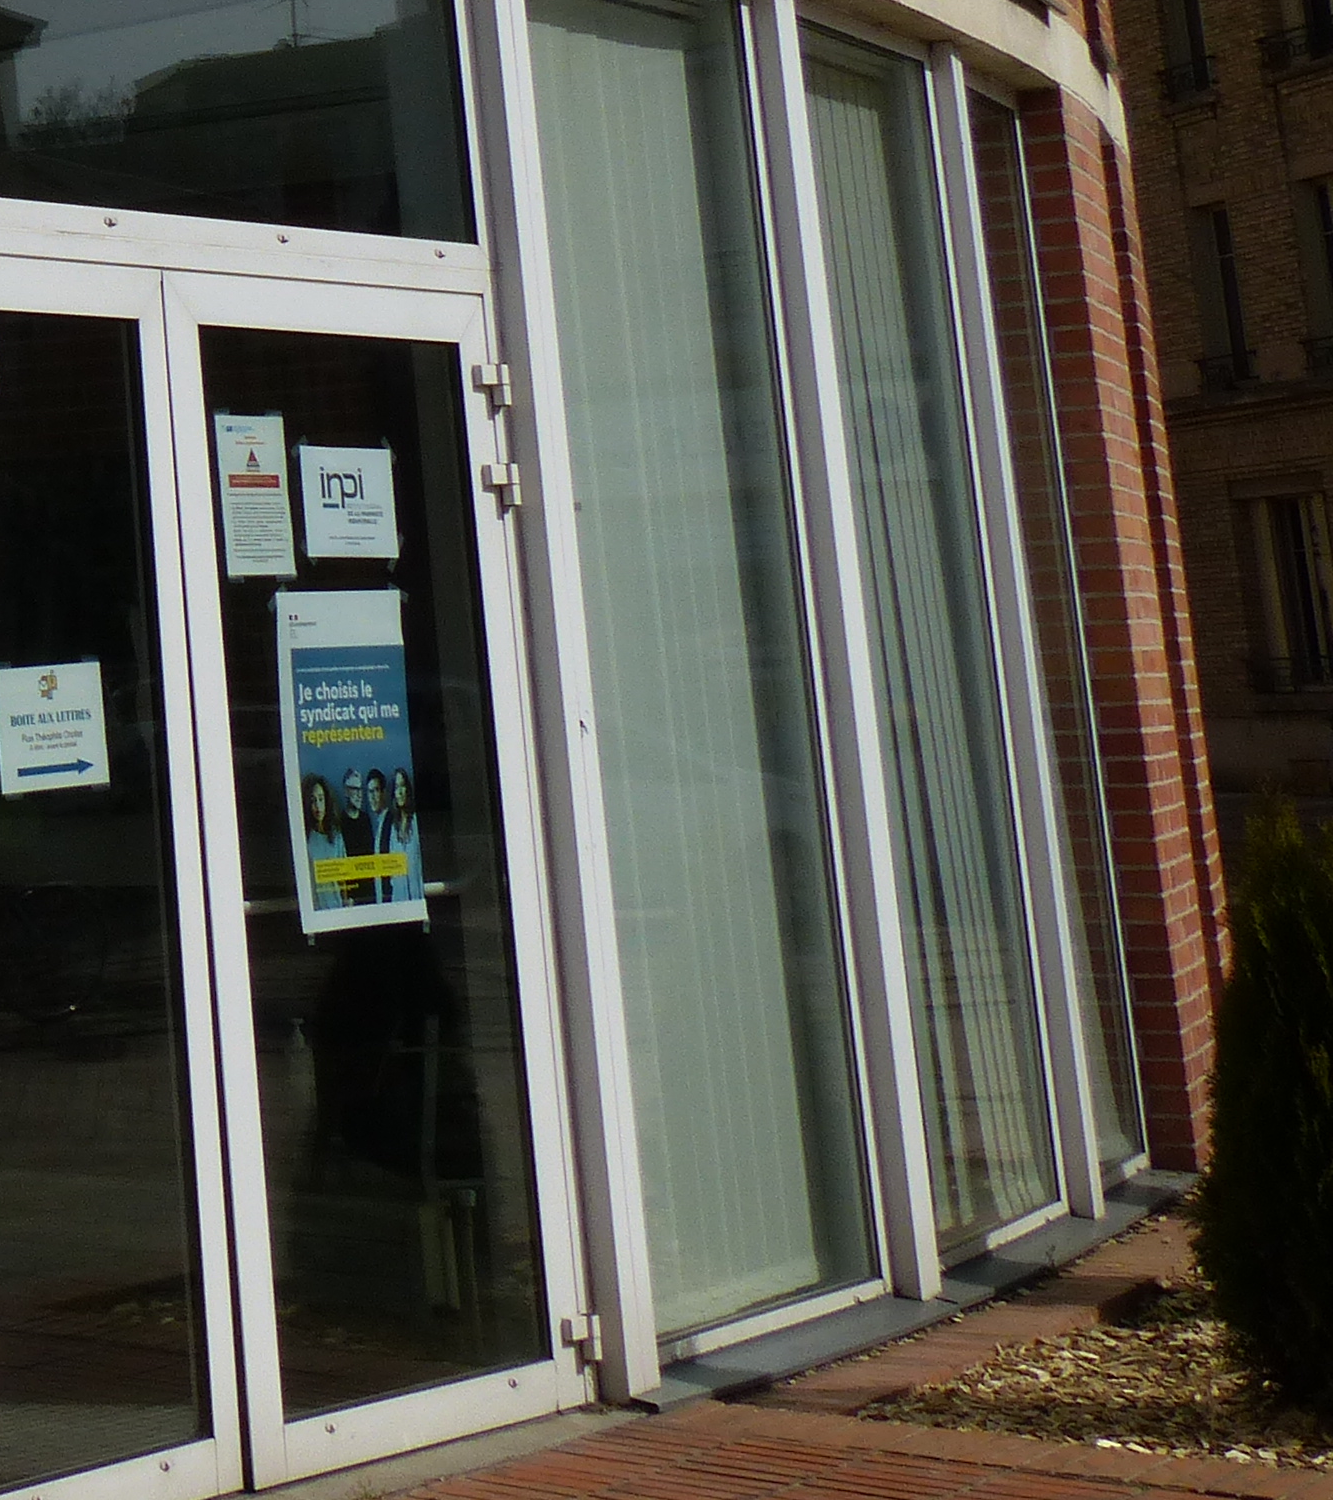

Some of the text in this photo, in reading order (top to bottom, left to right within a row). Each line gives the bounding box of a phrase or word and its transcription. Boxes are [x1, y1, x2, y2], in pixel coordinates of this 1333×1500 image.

[298, 679, 373, 705] Je choisis le
[10, 708, 92, 727] BOITE AUX LETTRES
[300, 700, 400, 728] syndicat qui me
[302, 724, 384, 749] représentera
